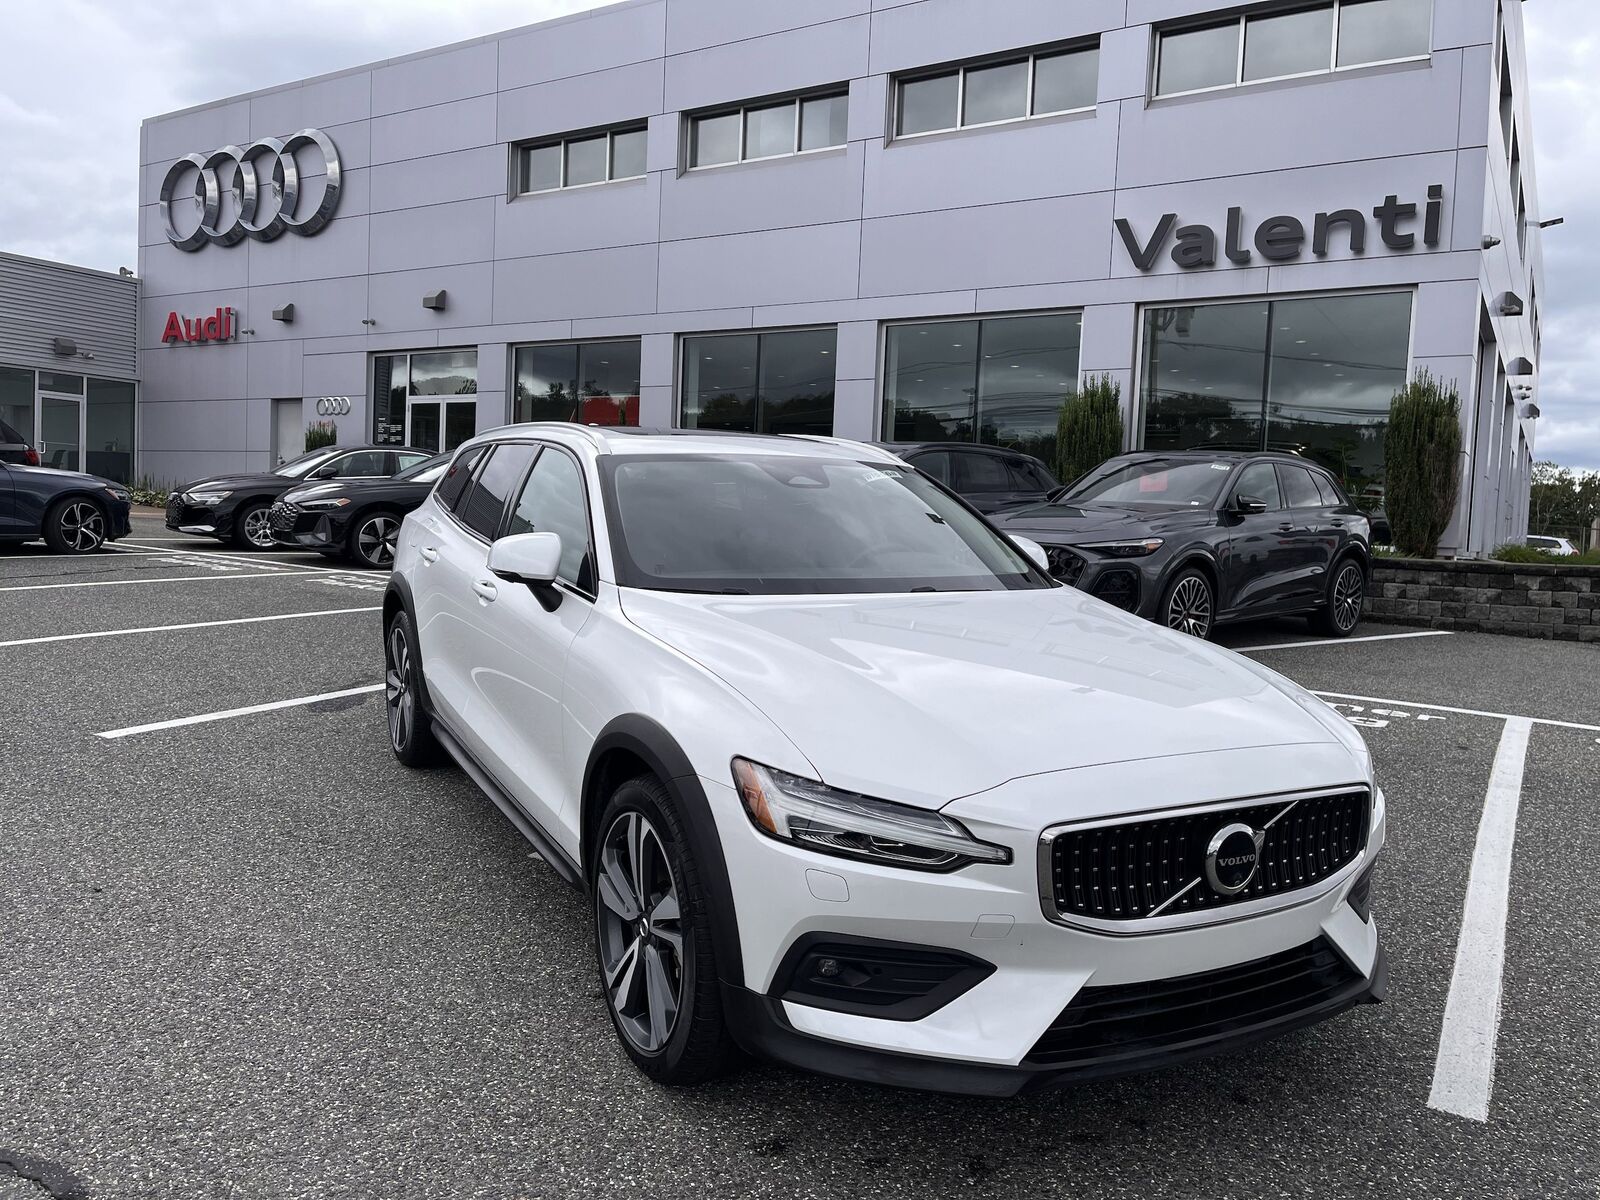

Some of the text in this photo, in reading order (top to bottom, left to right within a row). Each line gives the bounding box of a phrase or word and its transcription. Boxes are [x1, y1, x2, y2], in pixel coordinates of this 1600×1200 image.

[1114, 184, 1444, 271] Valenti
[161, 306, 236, 344] Audi
[1218, 853, 1256, 867] VOLVO
